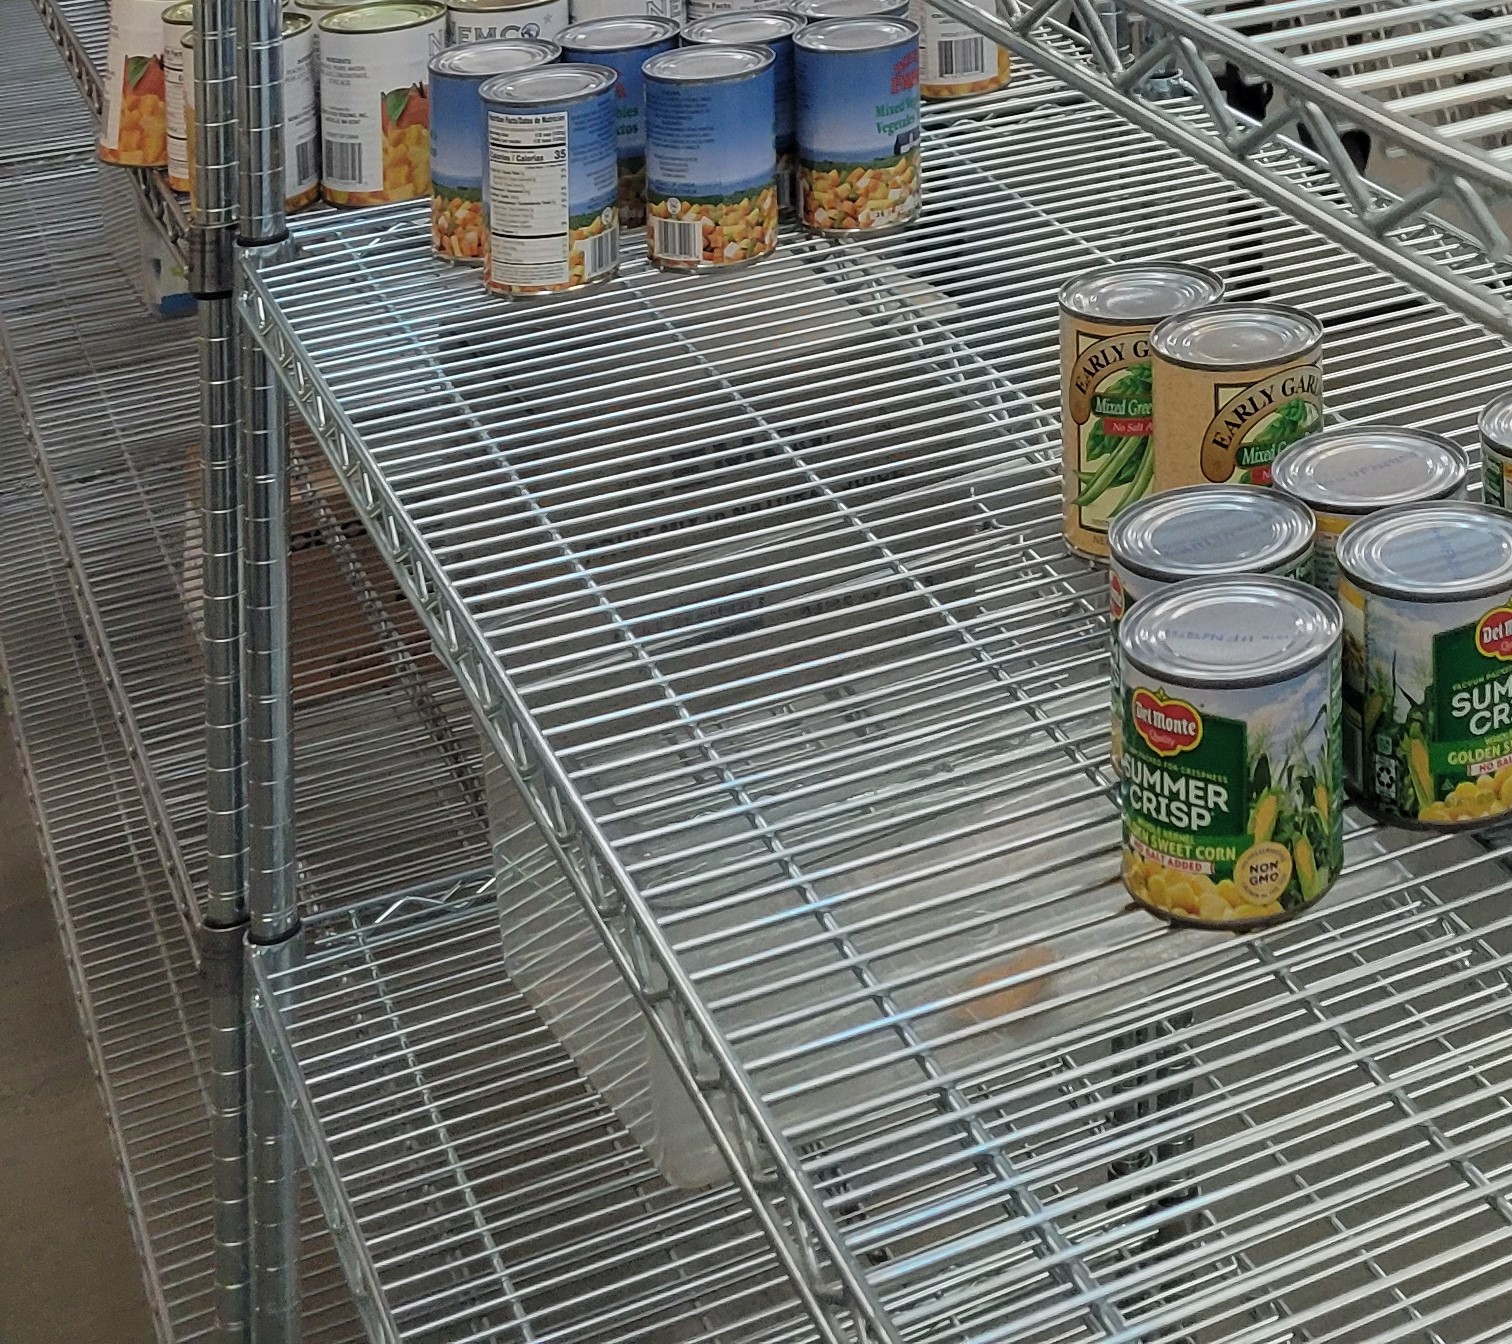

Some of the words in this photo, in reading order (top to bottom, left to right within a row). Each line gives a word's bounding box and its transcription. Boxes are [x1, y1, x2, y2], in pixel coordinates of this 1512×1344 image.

[554, 149, 567, 160] 35
[1075, 342, 1125, 396] EARLY
[1095, 396, 1127, 416] Mixed
[1113, 422, 1126, 432] No
[1127, 422, 1144, 433] Salt
[1212, 385, 1276, 451] EARLY
[1241, 446, 1276, 466] Mixed
[1482, 625, 1502, 644] Del
[1136, 701, 1152, 725] Del
[1153, 711, 1197, 737] Monte
[1447, 744, 1501, 765] GOLDEN
[1479, 761, 1494, 773] NO
[1122, 753, 1229, 813] SUMMER
[1129, 784, 1212, 831] CRISP
[1151, 833, 1193, 859] SWEET
[1195, 846, 1236, 862] CORN
[1145, 849, 1165, 864] SALT
[1167, 857, 1203, 872] ADDED
[1249, 860, 1280, 875] NON
[1249, 871, 1280, 886] GMO
